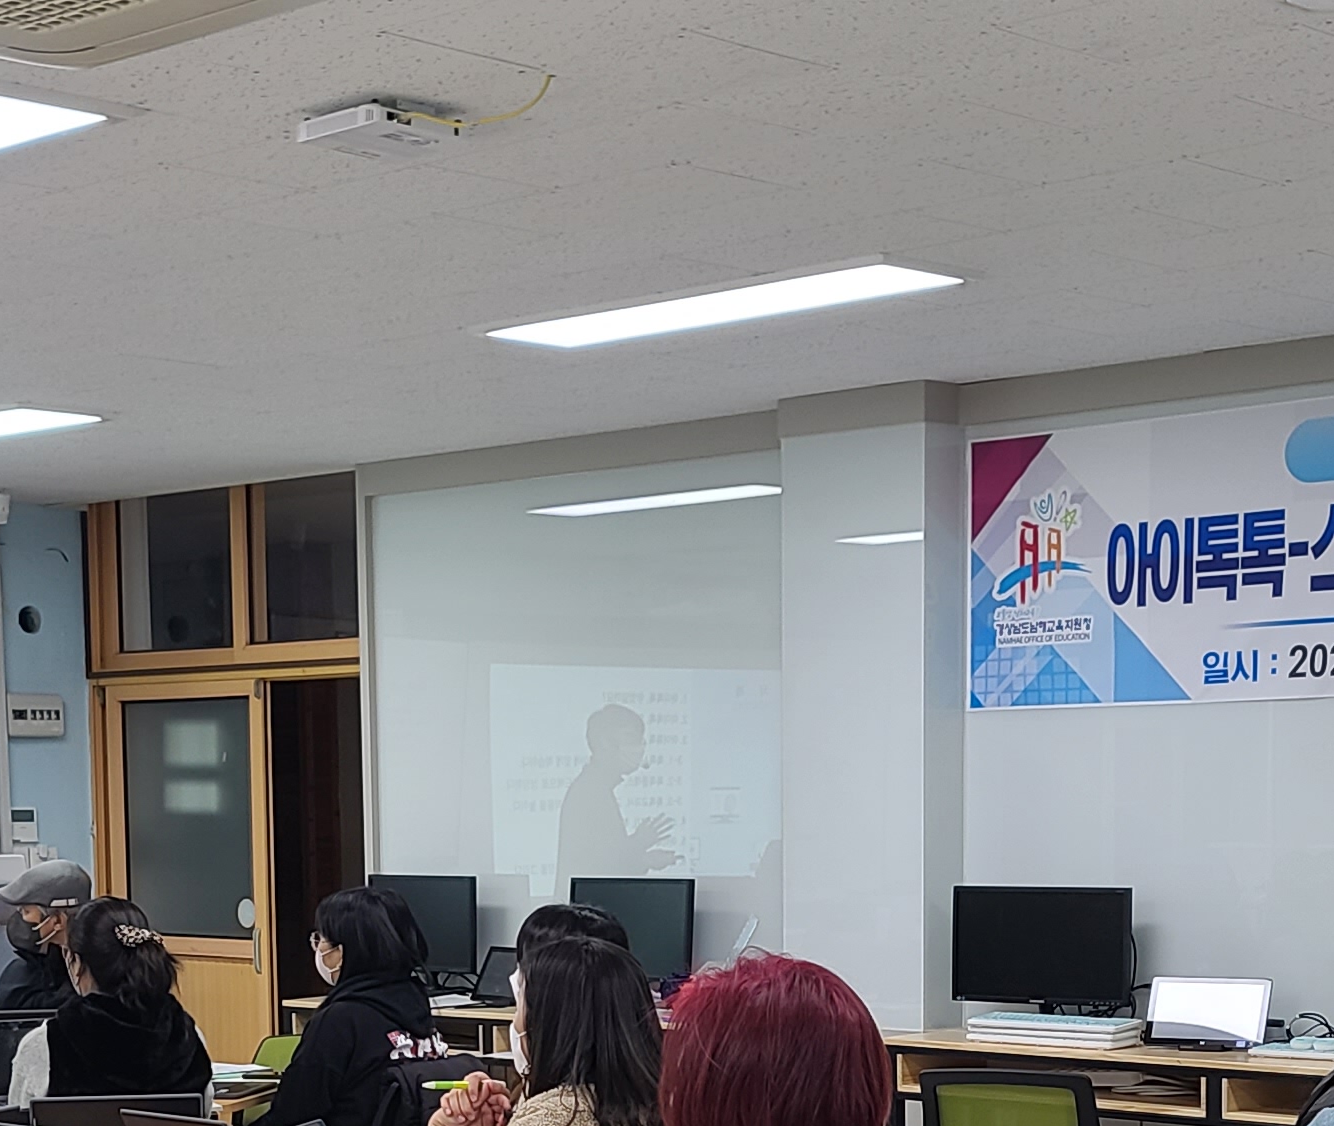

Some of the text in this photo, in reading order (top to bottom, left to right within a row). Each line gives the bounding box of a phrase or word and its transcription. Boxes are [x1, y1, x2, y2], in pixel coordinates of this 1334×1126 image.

[1024, 635, 1044, 644] OFFICE
[1054, 633, 1090, 642] EDUCATION
[1202, 649, 1260, 685] 일시
